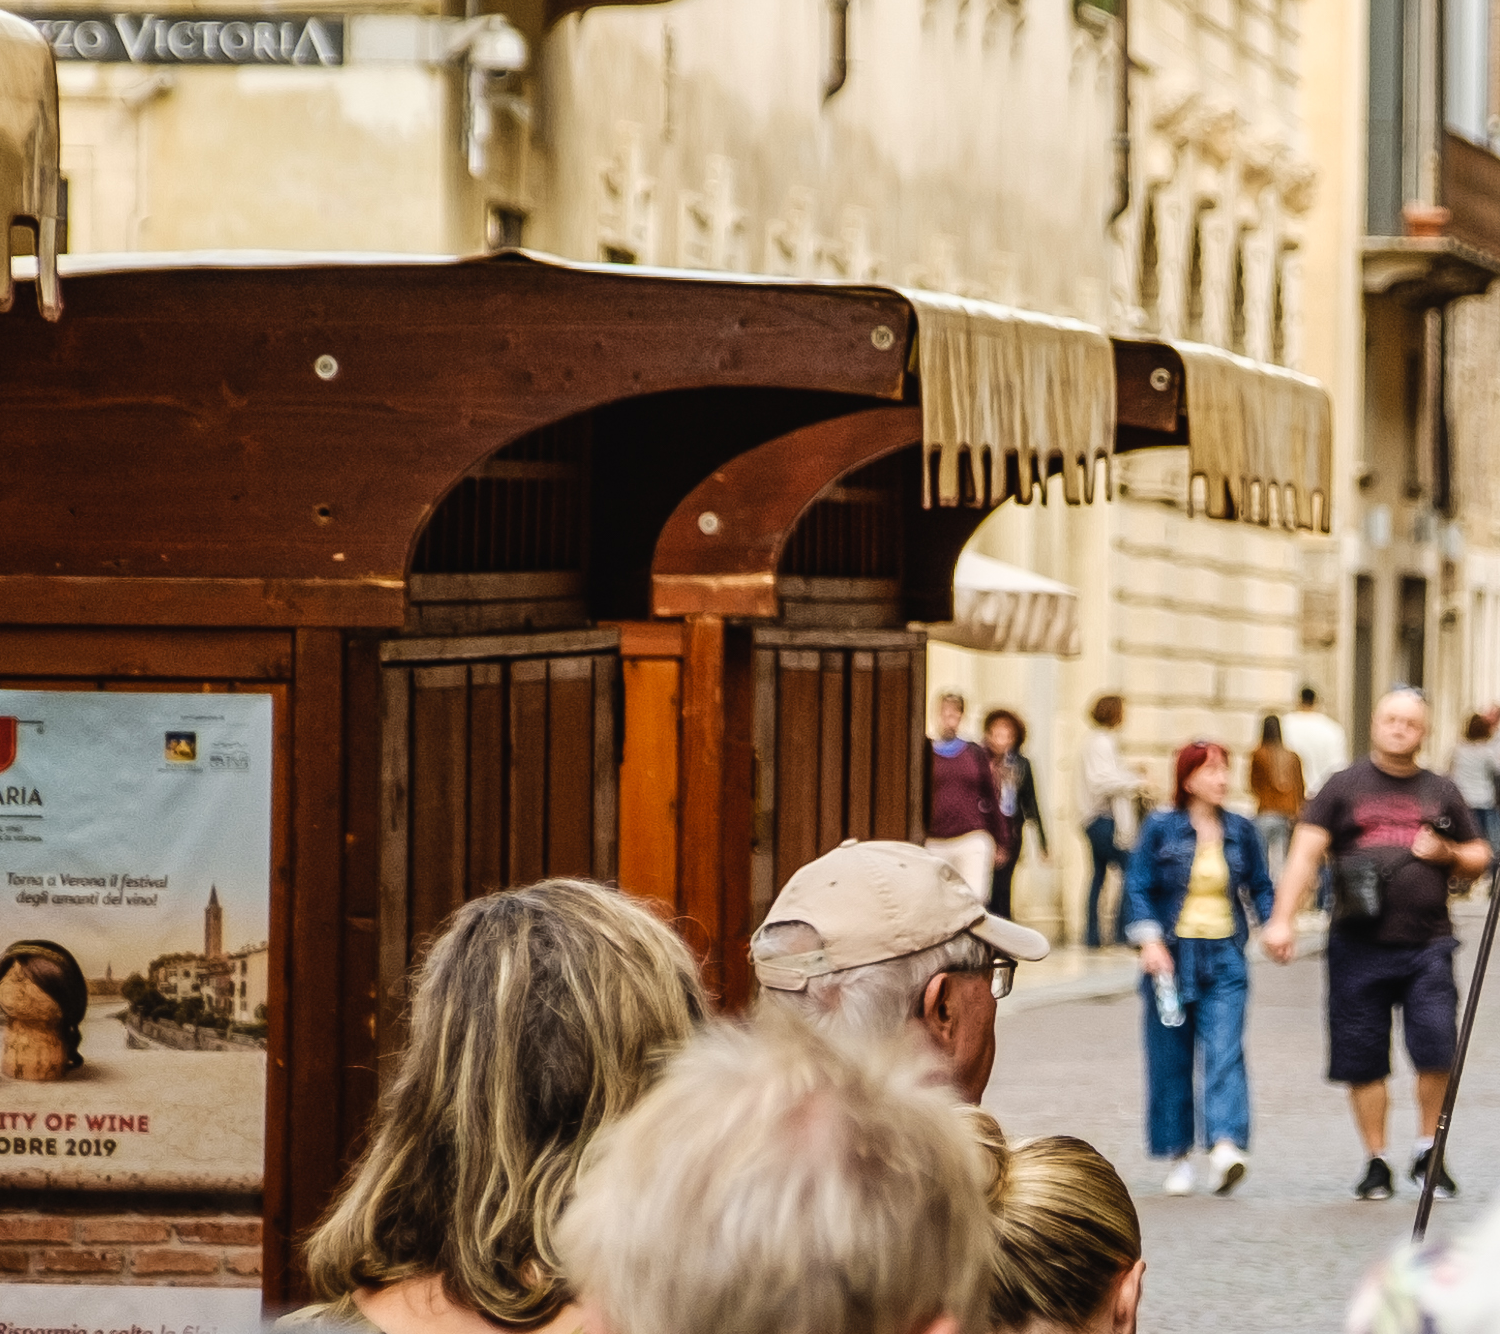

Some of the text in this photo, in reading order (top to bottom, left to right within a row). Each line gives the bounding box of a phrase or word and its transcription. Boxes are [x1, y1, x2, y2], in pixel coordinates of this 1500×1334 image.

[113, 13, 340, 66] VICTORIA
[7, 872, 44, 886] Torna
[47, 876, 56, 887] a
[60, 873, 106, 887] Verona
[119, 873, 169, 893] festival
[15, 890, 49, 907] degli
[52, 892, 99, 905] amanti
[102, 892, 123, 905] del
[45, 1113, 77, 1132] OF
[84, 1114, 149, 1133] WINE
[65, 1138, 117, 1157] 2019
